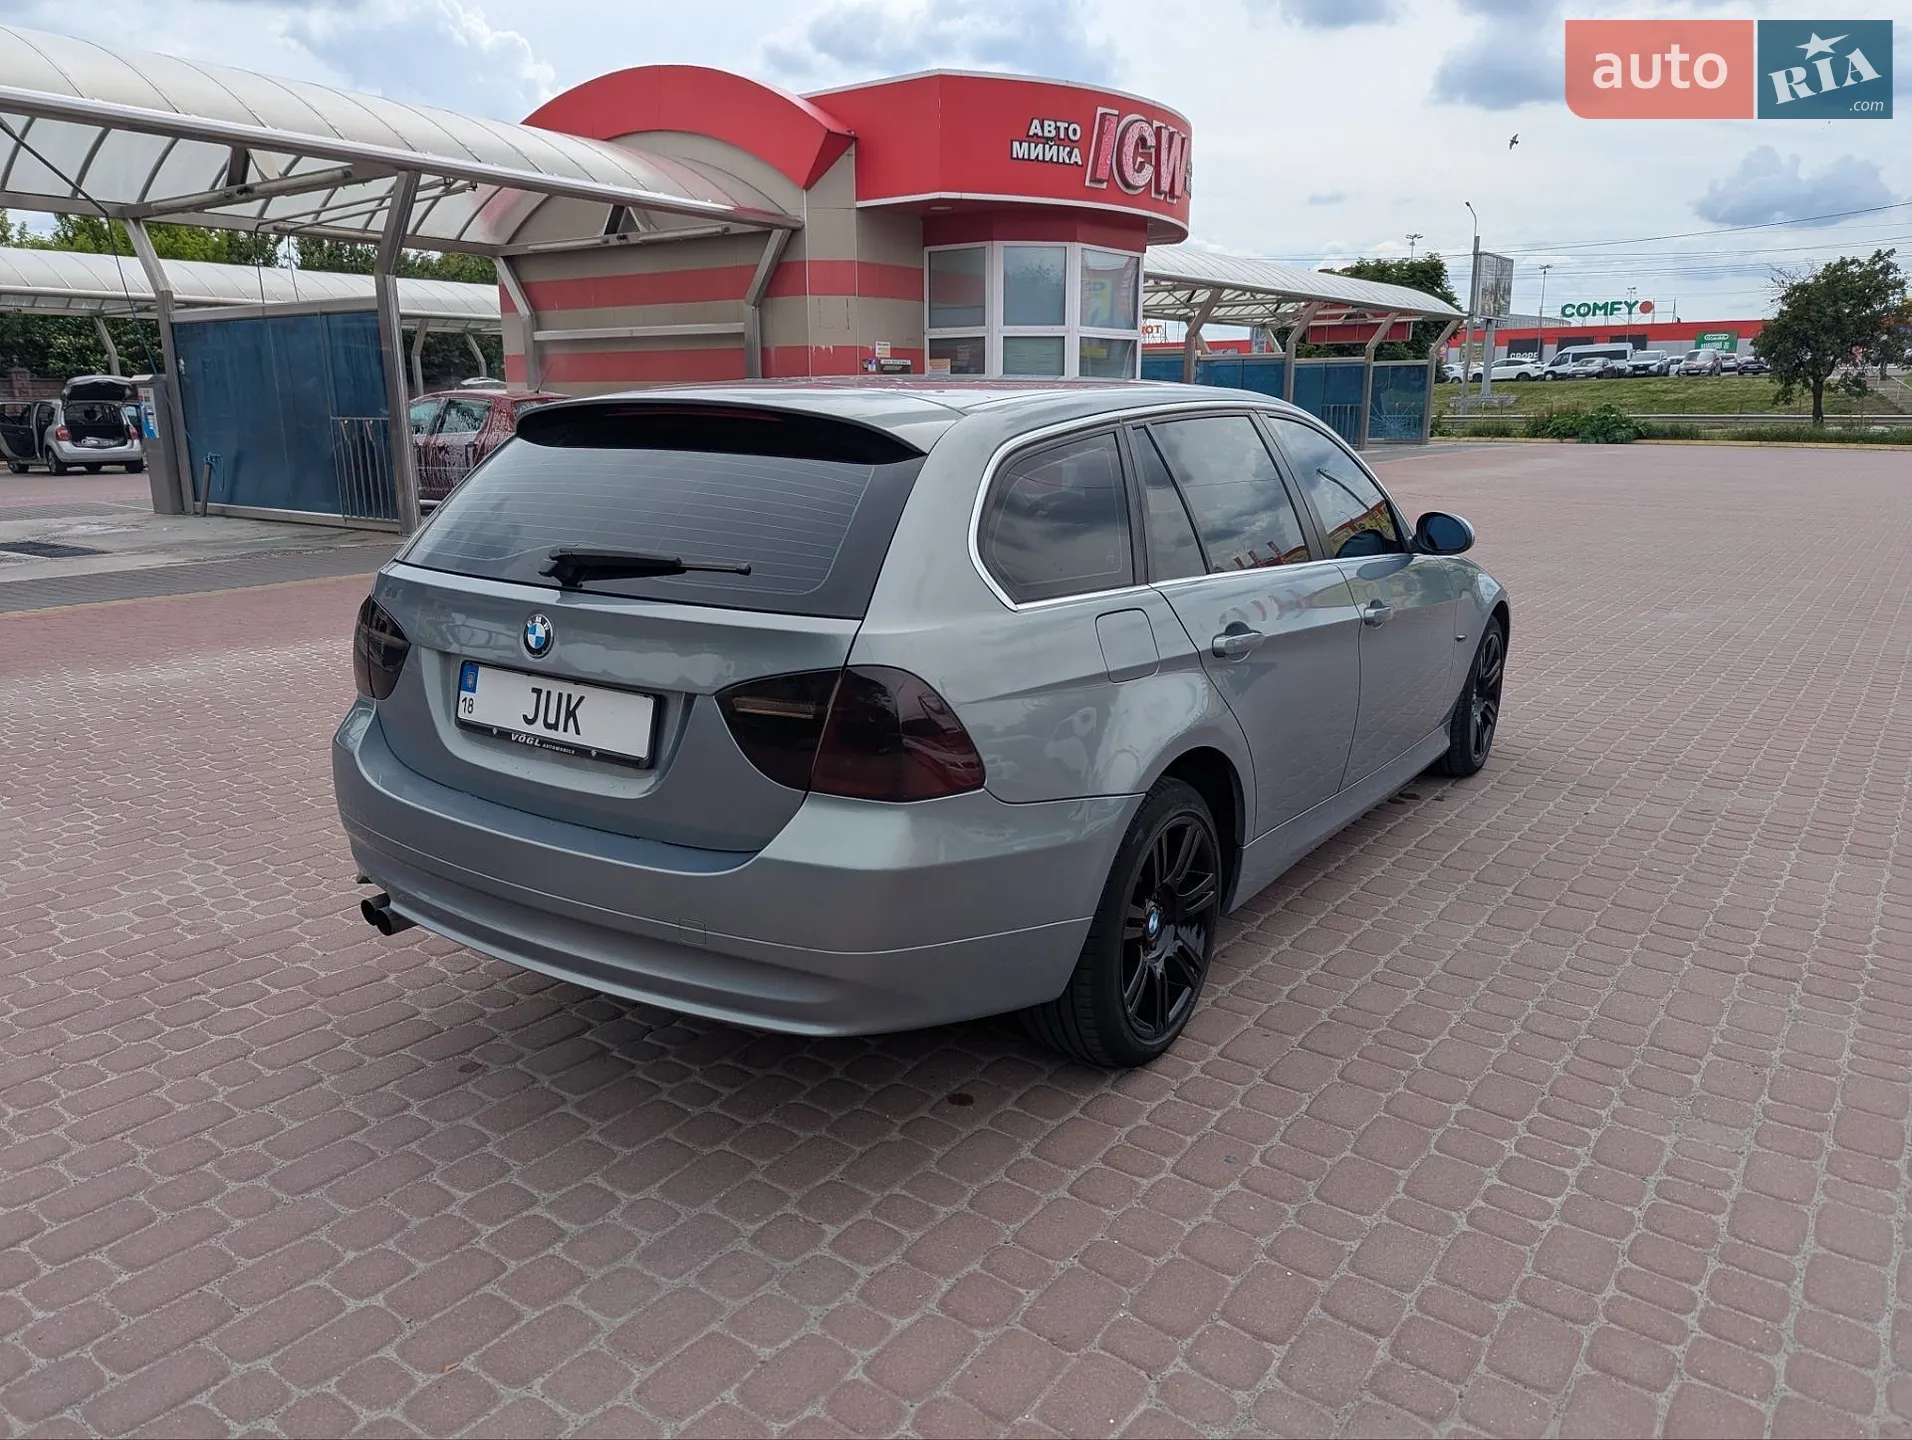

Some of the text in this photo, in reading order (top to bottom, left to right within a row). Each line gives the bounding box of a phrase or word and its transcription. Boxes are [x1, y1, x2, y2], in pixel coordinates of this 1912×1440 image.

[1028, 118, 1082, 141] АВТО
[1011, 141, 1083, 166] МИЙКА
[1561, 300, 1639, 318] COMFY
[461, 697, 474, 714] 18
[522, 687, 585, 736] JUK
[511, 733, 541, 747] VÖGL
